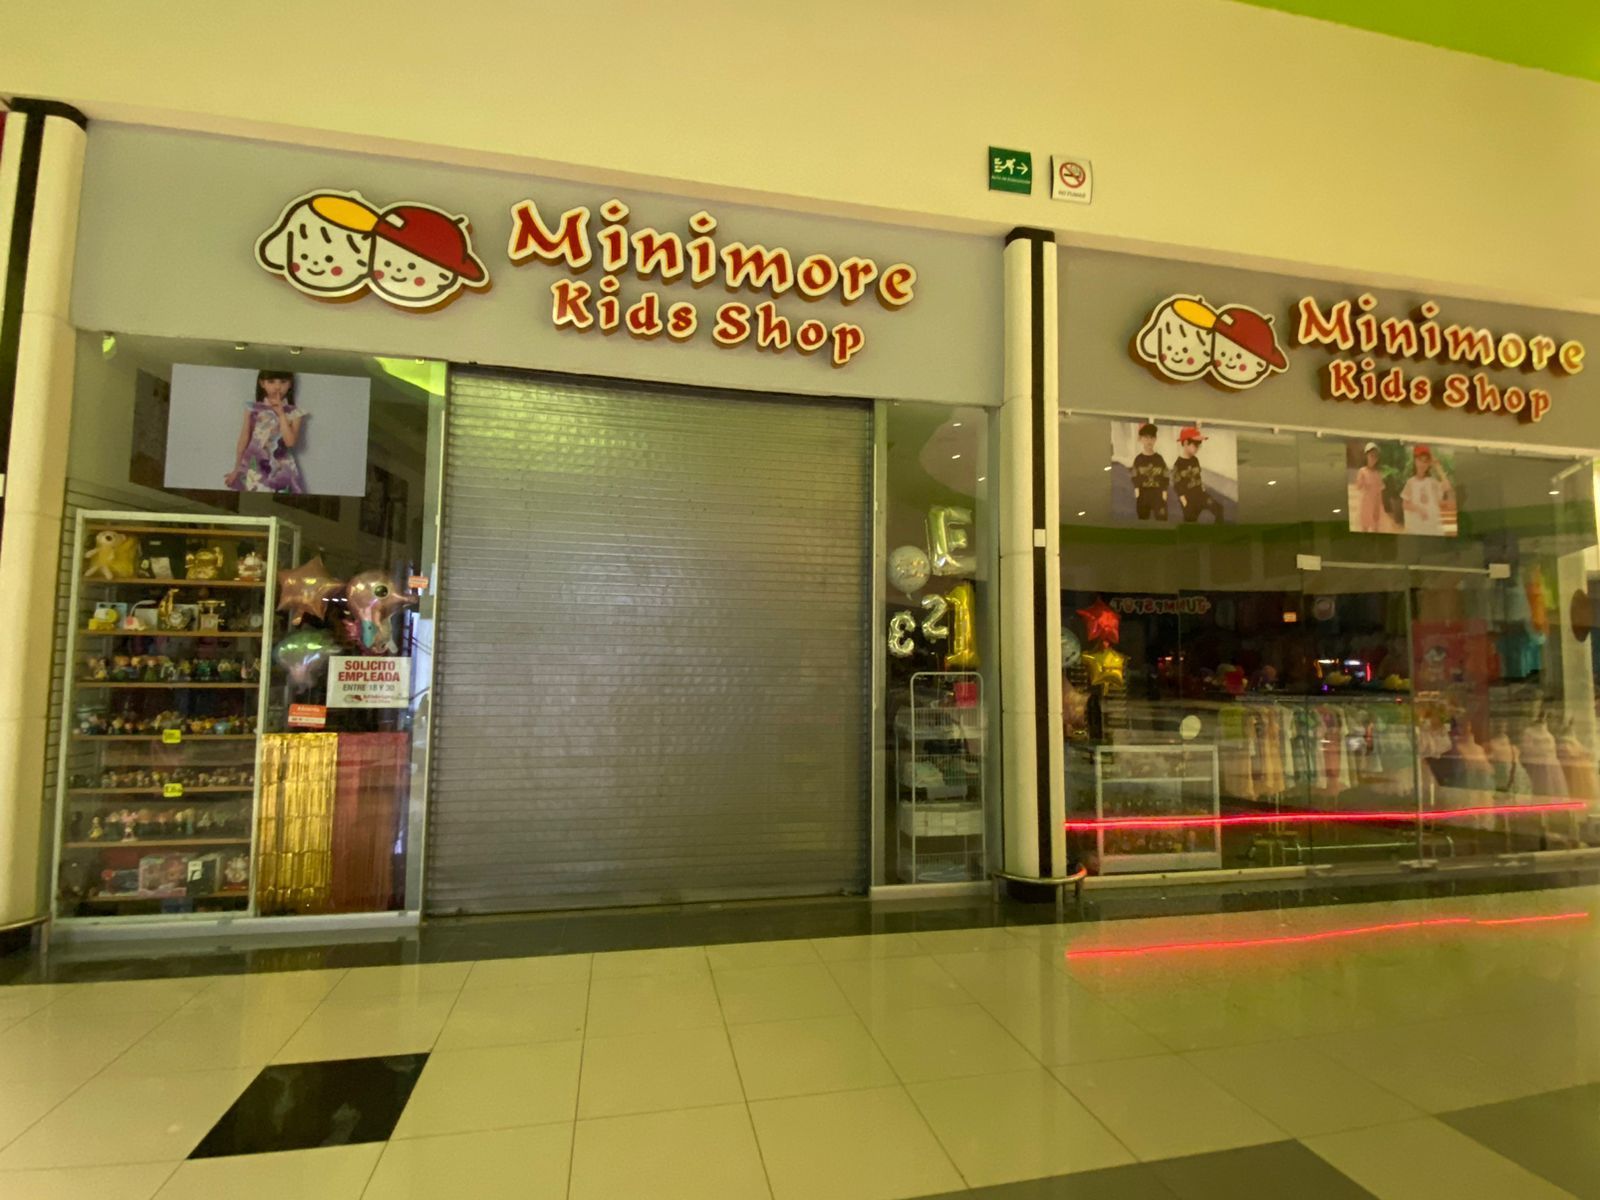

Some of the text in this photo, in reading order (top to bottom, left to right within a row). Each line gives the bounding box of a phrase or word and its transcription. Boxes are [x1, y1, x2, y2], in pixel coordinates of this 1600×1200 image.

[508, 199, 917, 305] Minimore
[551, 275, 865, 364] Kids Shop
[1298, 293, 1585, 374] Minimore
[1329, 357, 1551, 423] Kids Shop
[338, 671, 400, 682] EMPLEADA
[344, 660, 396, 671] SOLICITO
